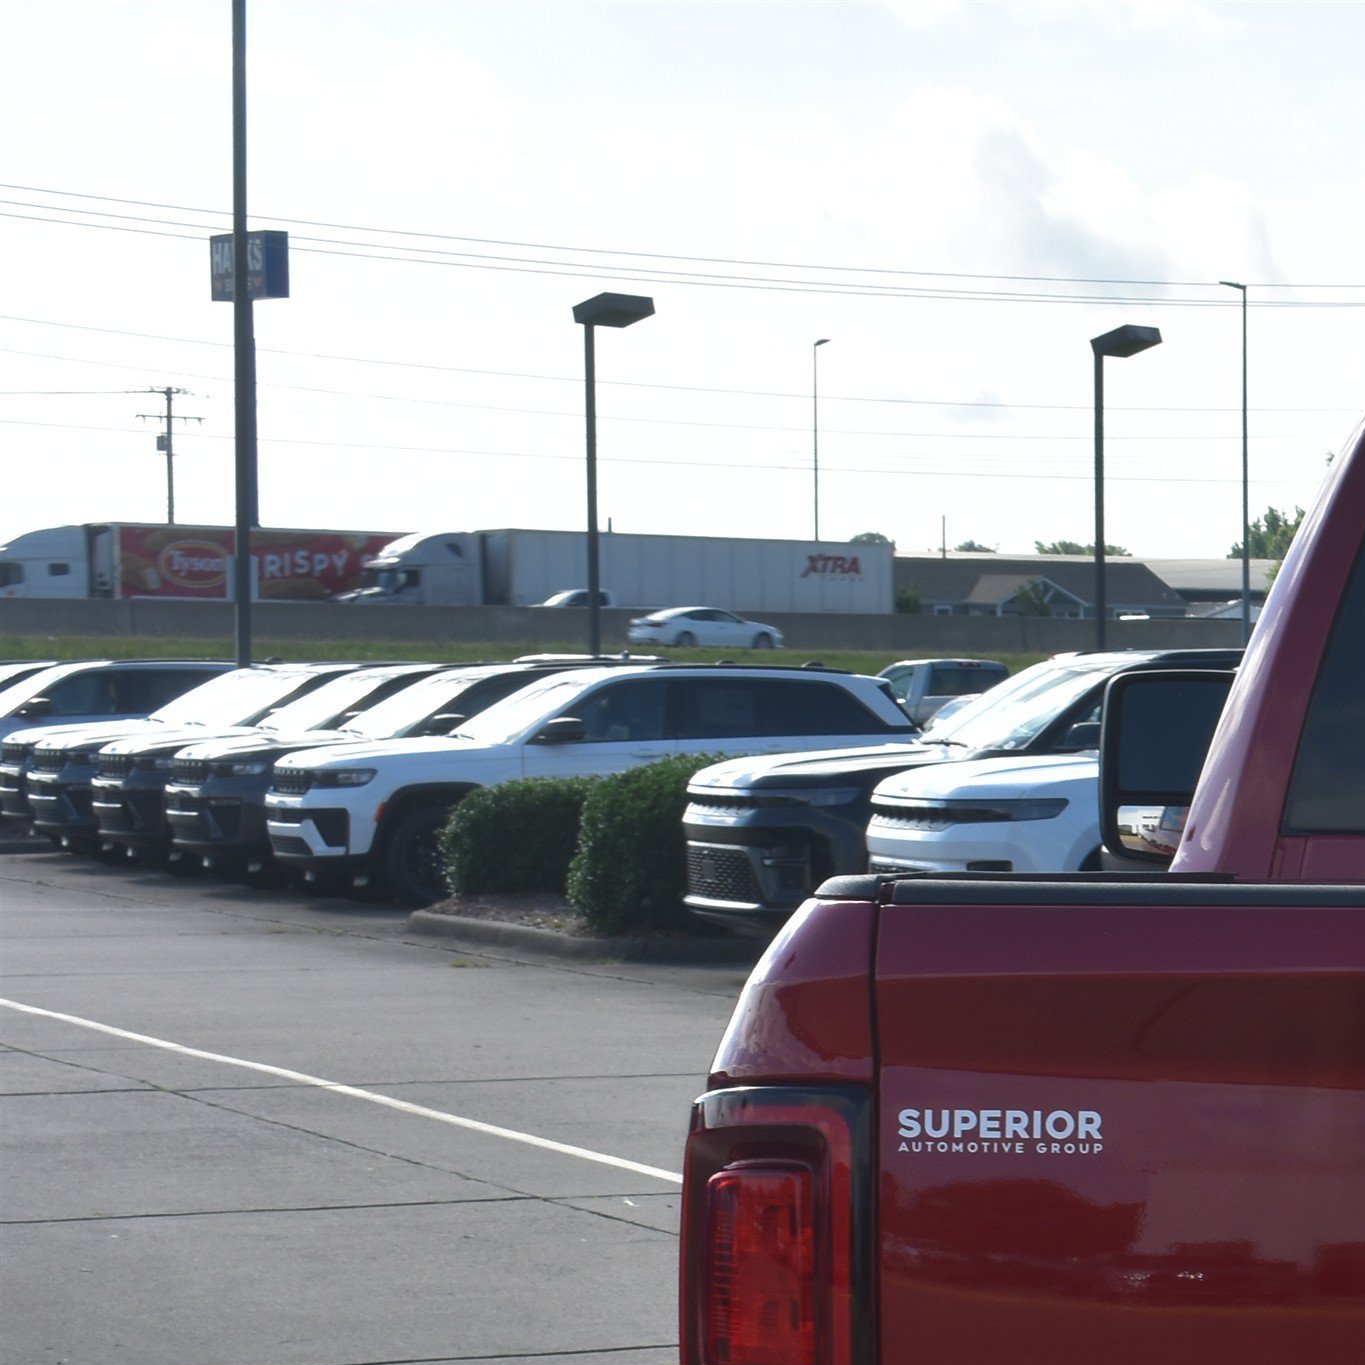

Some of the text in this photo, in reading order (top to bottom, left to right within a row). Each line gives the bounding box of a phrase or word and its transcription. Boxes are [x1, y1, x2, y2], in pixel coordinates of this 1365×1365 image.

[264, 549, 350, 577] RISPY
[799, 553, 861, 578] XTRA
[897, 1108, 1103, 1140] SUPERIOR
[897, 1141, 1104, 1155] AUTOMOTIVE GROUP
